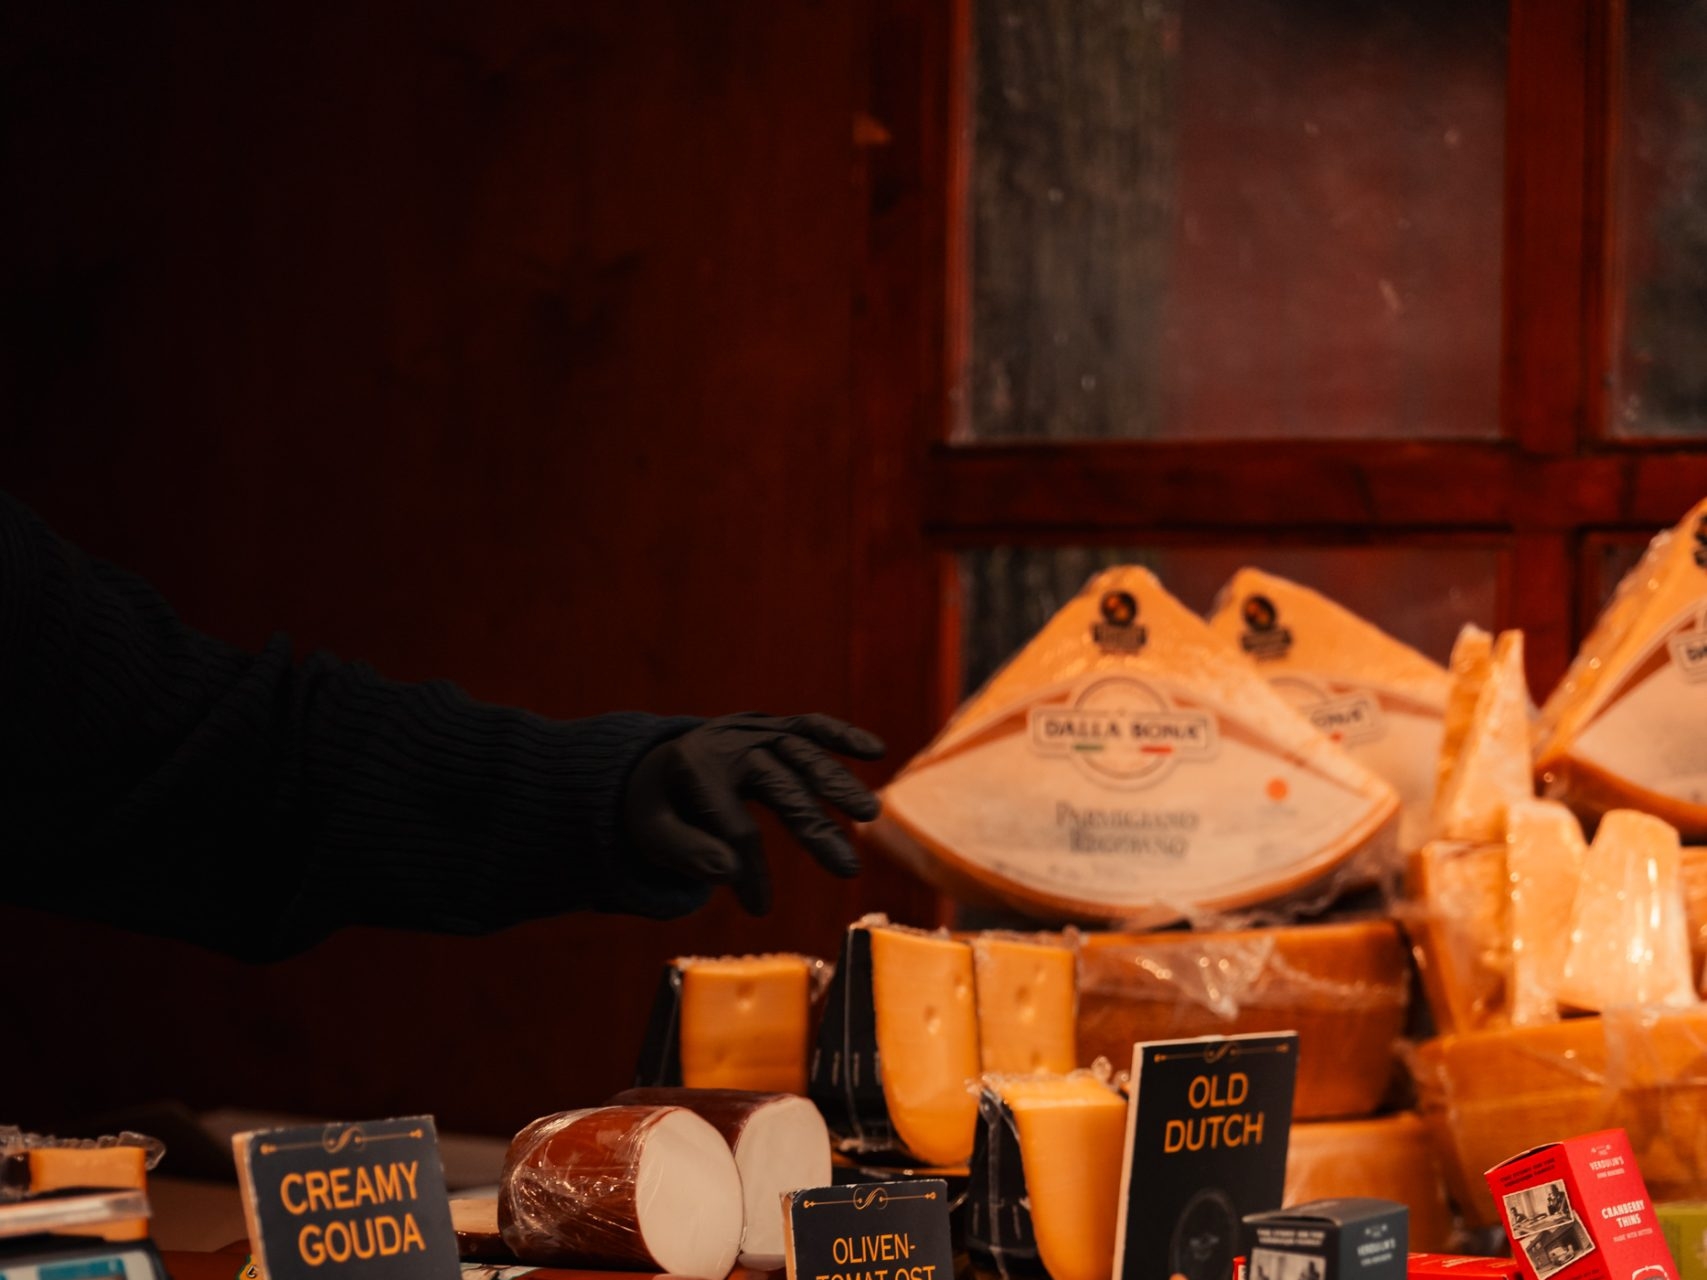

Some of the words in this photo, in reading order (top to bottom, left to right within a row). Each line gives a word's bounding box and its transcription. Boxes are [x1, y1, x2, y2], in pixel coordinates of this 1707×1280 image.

[1044, 717, 1121, 738] DALLA
[1130, 718, 1200, 740] BONA
[1188, 1072, 1249, 1110] OLD
[1164, 1112, 1265, 1154] DUTCH
[280, 1160, 418, 1215] CREAMY
[1601, 1199, 1645, 1219] CRANBERRY
[1616, 1213, 1642, 1229] THINS
[298, 1213, 427, 1267] GOUDA
[832, 1233, 916, 1266] OLIVEN-
